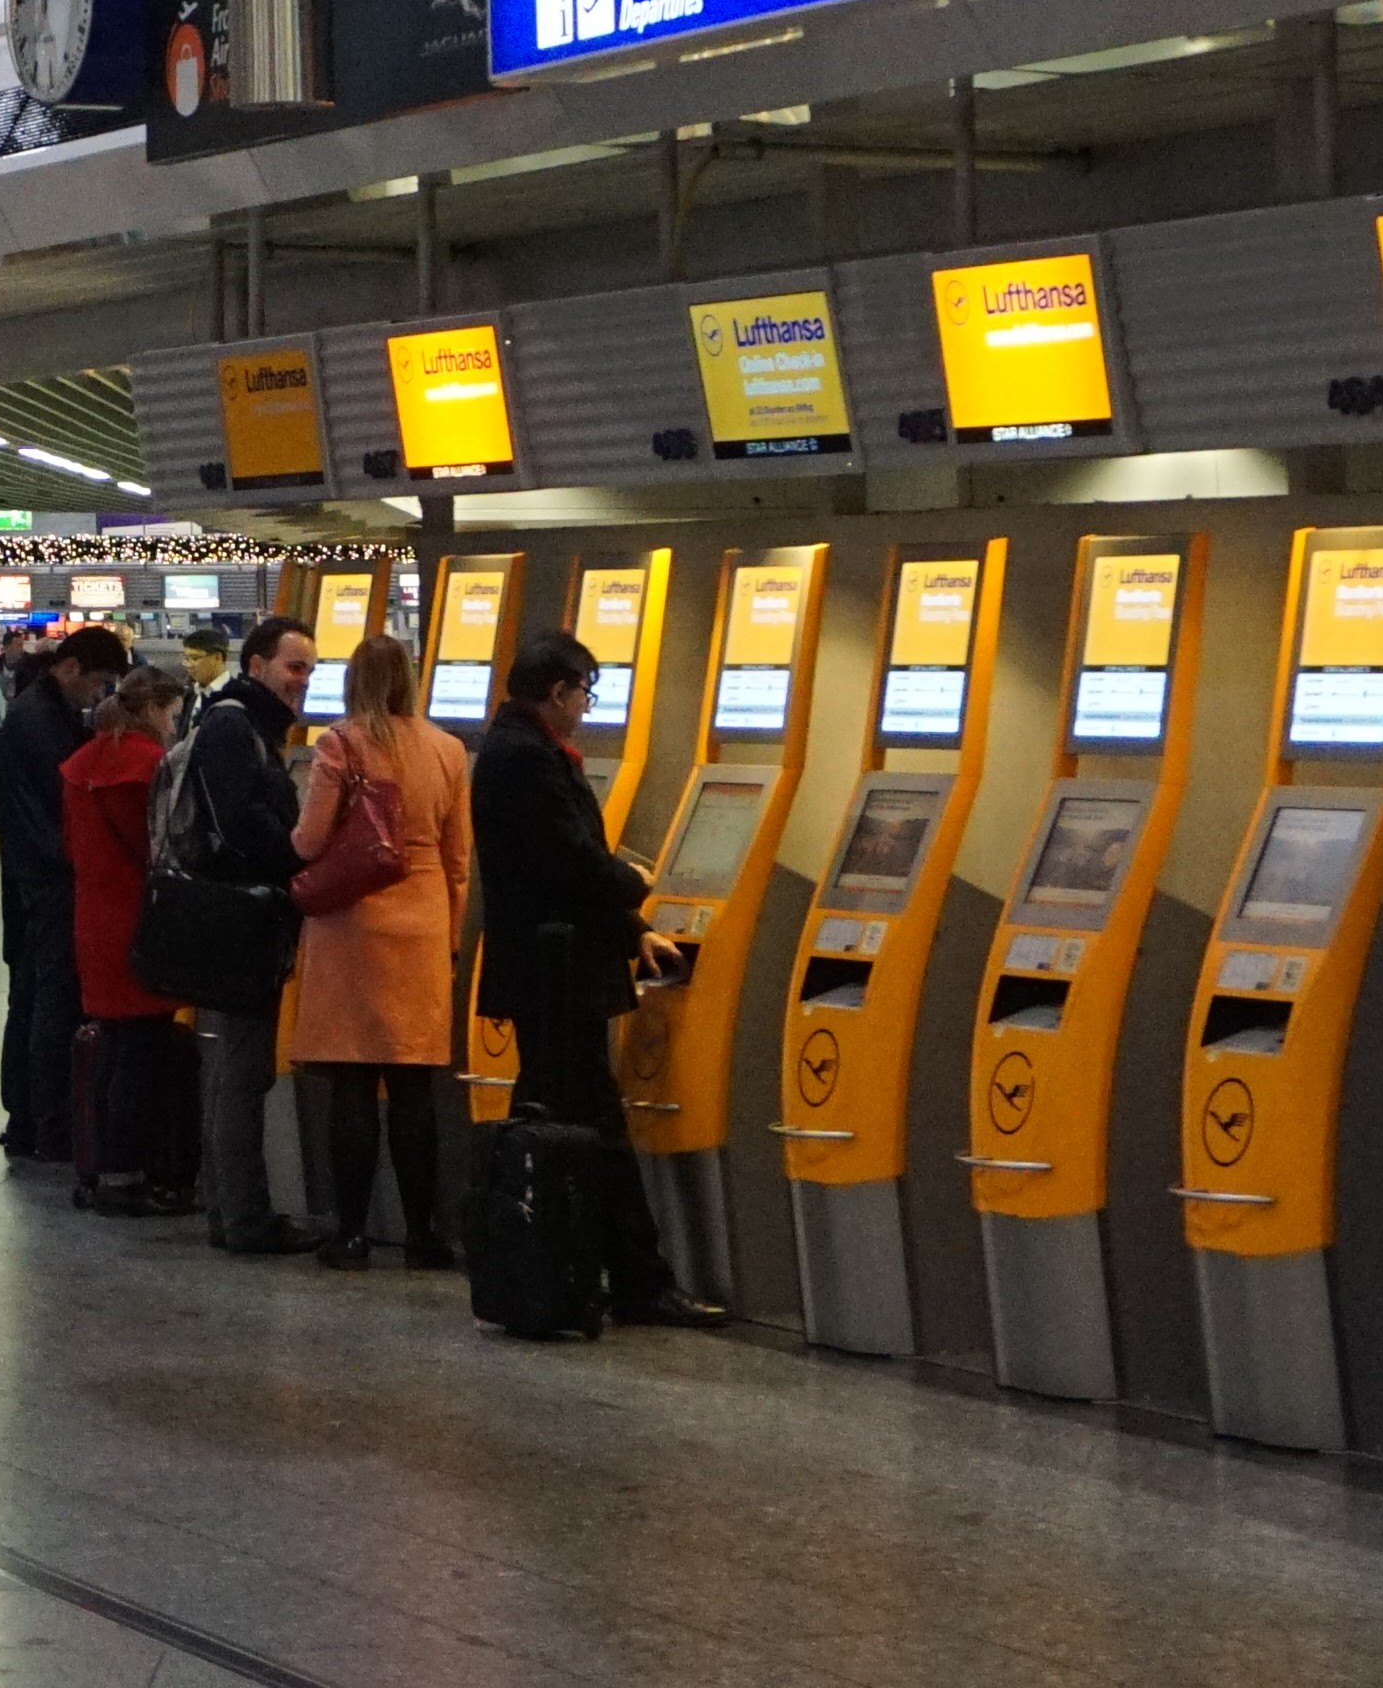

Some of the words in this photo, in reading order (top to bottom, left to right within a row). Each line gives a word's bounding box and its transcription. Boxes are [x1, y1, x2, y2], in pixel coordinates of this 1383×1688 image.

[982, 279, 1088, 315] Lufthansa
[732, 314, 825, 348] Lufthansa
[420, 348, 493, 376] Lufthansa
[244, 365, 308, 393] Lufthansa
[72, 581, 123, 592] TICKETS
[754, 576, 798, 595] Lufthansa
[922, 572, 972, 590] Lufthansa
[1118, 566, 1174, 587] Lufthansa
[600, 579, 641, 597] Lufthansa
